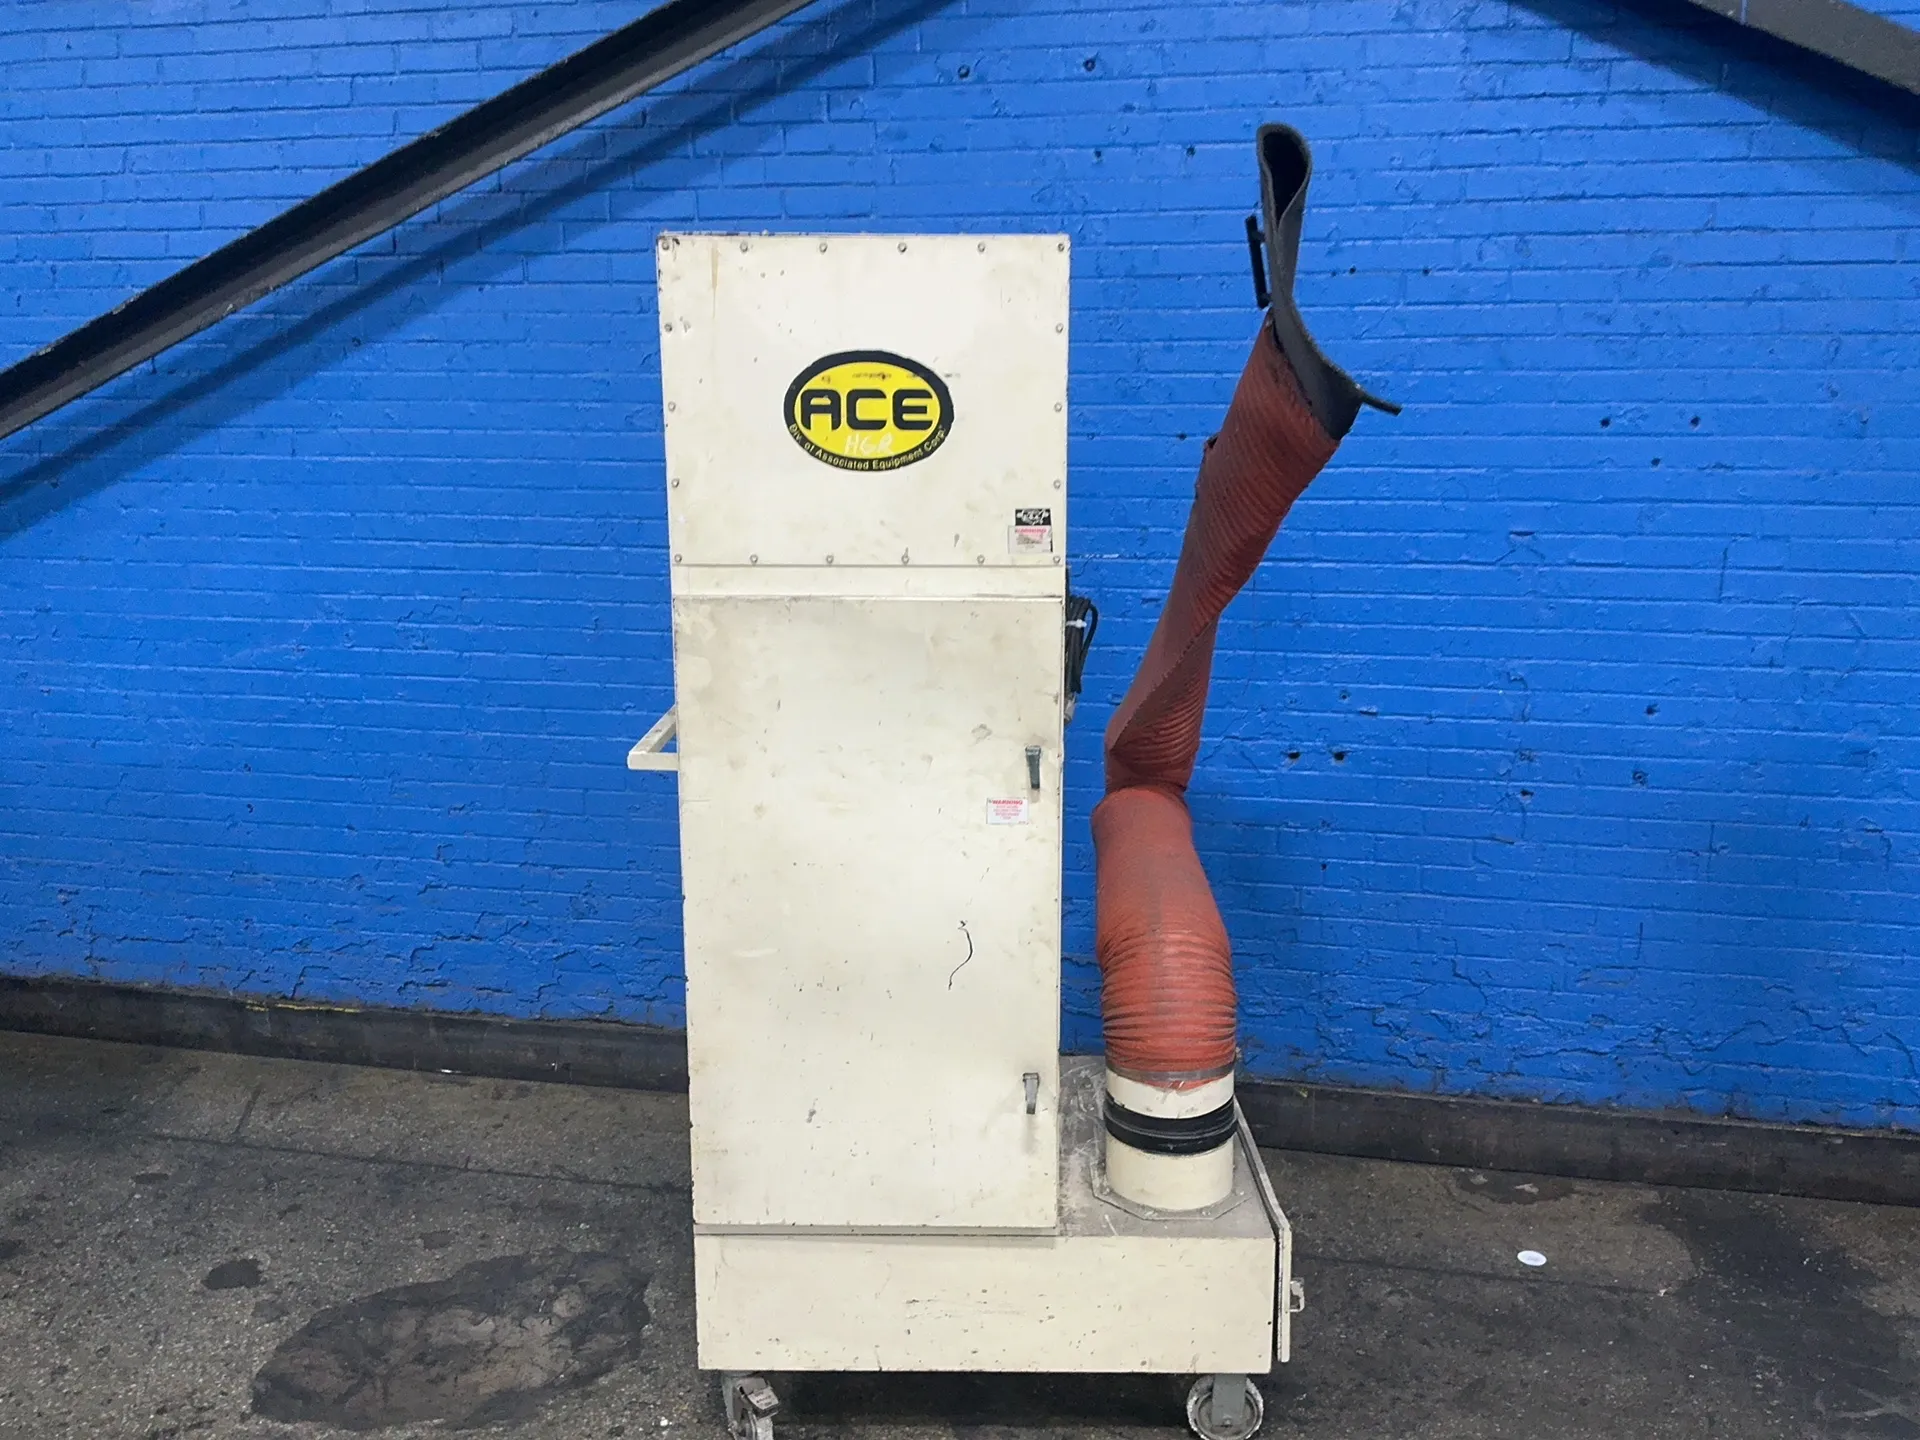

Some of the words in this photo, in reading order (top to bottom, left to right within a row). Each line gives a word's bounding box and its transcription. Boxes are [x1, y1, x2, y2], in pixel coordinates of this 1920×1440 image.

[800, 389, 934, 431] ACE
[804, 441, 815, 453] of
[815, 448, 869, 470] Associated
[872, 448, 923, 470] Equipment
